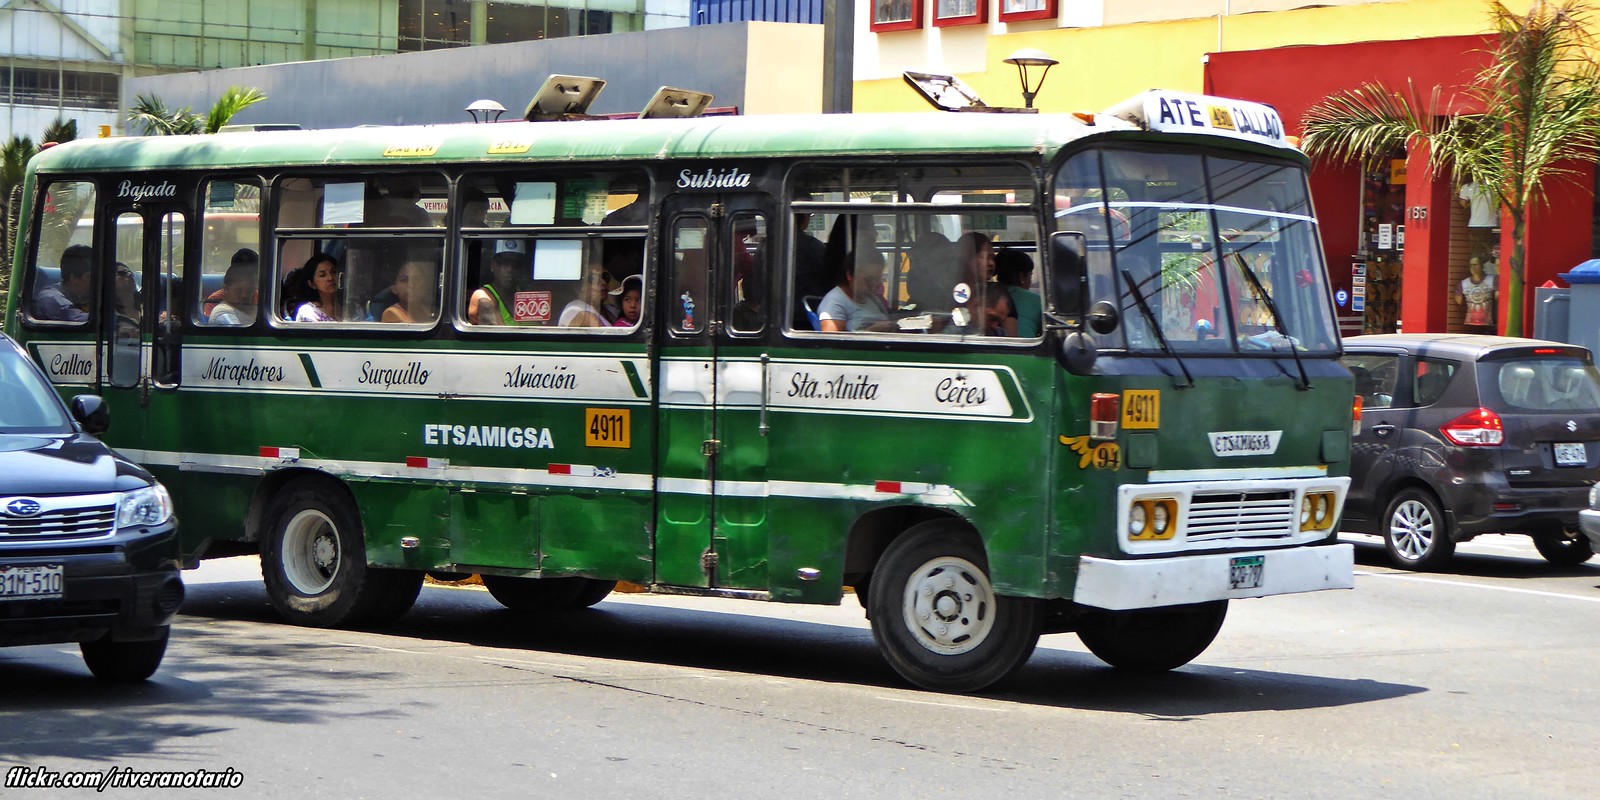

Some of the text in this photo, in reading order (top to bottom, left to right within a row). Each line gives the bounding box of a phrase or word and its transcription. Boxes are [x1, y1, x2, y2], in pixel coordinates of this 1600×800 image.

[1159, 97, 1205, 127] ATE
[1233, 107, 1280, 141] CALLAO
[117, 180, 177, 201] Bajada
[676, 168, 751, 189] Subida
[50, 353, 92, 376] Callao
[201, 356, 286, 386] Miraflores
[358, 360, 432, 390] Surquillo
[504, 365, 578, 390] Aviación
[787, 372, 880, 401] Sta. Anita
[1126, 394, 1156, 423] 4911
[424, 423, 555, 449] ETSAMIGSA
[590, 414, 624, 441] 4911
[1215, 434, 1271, 453] ETSAMIGSA
[1097, 447, 1119, 468] 94
